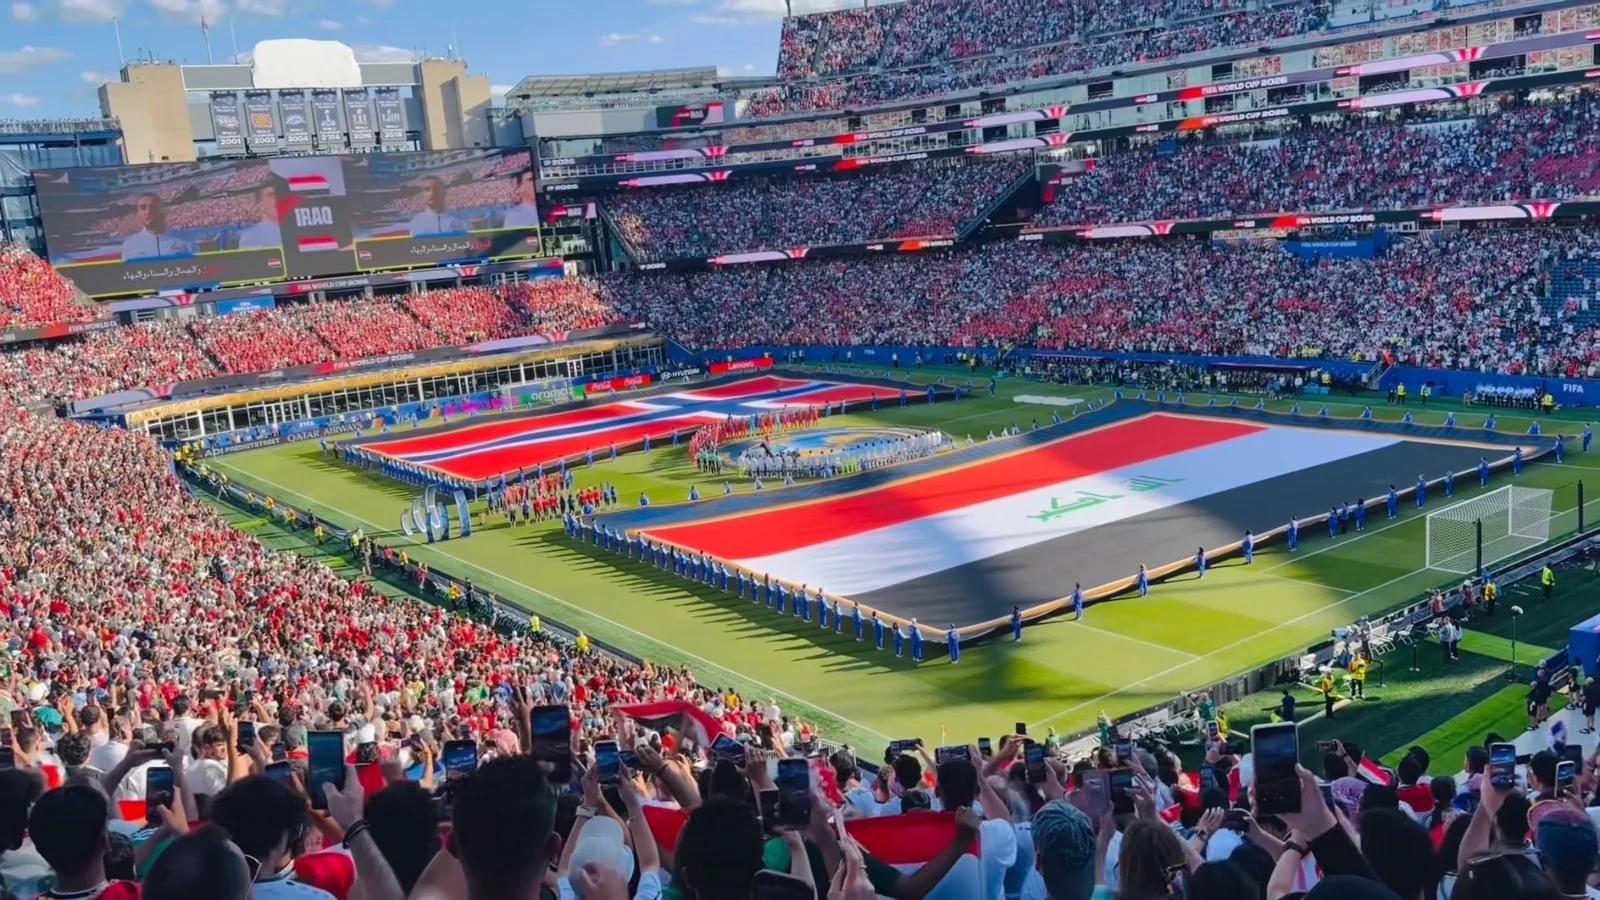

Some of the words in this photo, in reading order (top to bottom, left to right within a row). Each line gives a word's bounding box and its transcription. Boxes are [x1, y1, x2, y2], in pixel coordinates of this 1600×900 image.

[1202, 87, 1217, 95] FIFA
[1218, 83, 1244, 93] WORLD
[1245, 80, 1260, 89] CUP
[1261, 77, 1288, 86] 2026
[1218, 113, 1245, 123] WORLD
[1246, 111, 1261, 120] CUP
[1261, 108, 1288, 117] 2026
[868, 131, 891, 139] WORLD
[891, 129, 904, 137] CUP
[904, 127, 926, 135] 2026
[294, 206, 333, 226] IRAQ
[1311, 216, 1337, 224] WORLD
[1337, 215, 1349, 223] CUP
[1350, 214, 1375, 222] 2026
[312, 282, 334, 290] WORLD
[86, 322, 108, 330] WORLD
[333, 362, 349, 370] FIFA
[350, 358, 375, 367] WORLD
[376, 355, 390, 364] CUP
[727, 360, 754, 370] Lenovo
[531, 387, 573, 401] aramco
[1563, 383, 1584, 393] FIFA
[394, 412, 417, 423] VISA
[287, 430, 319, 443] QATAR
[323, 421, 364, 436] AIRWAYS
[225, 437, 281, 452] PREDICTSTREET
